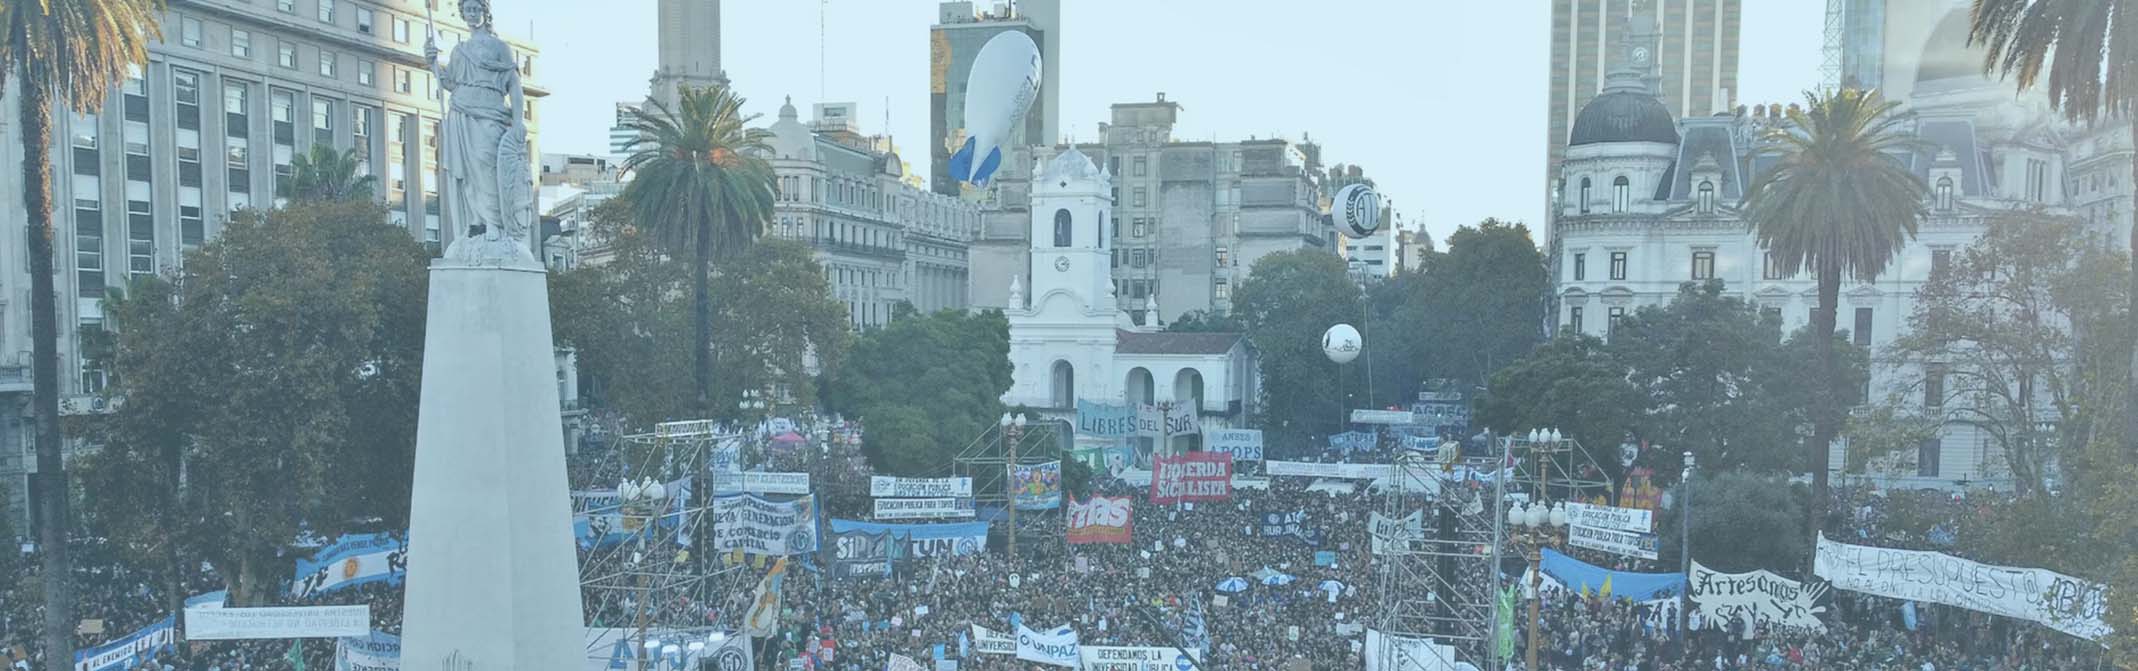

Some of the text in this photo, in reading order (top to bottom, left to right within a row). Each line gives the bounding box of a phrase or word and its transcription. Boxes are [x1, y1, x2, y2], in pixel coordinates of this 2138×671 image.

[1081, 413, 1192, 435] LIBRES DEL SUR
[725, 536, 768, 551] CAPITAL
[1695, 570, 1799, 601] Artesanos
[1876, 550, 2039, 604] PRESUPUESTO
[1031, 638, 1076, 659] UNPAZ
[1097, 649, 1162, 661] DEFENDAMOS LA
